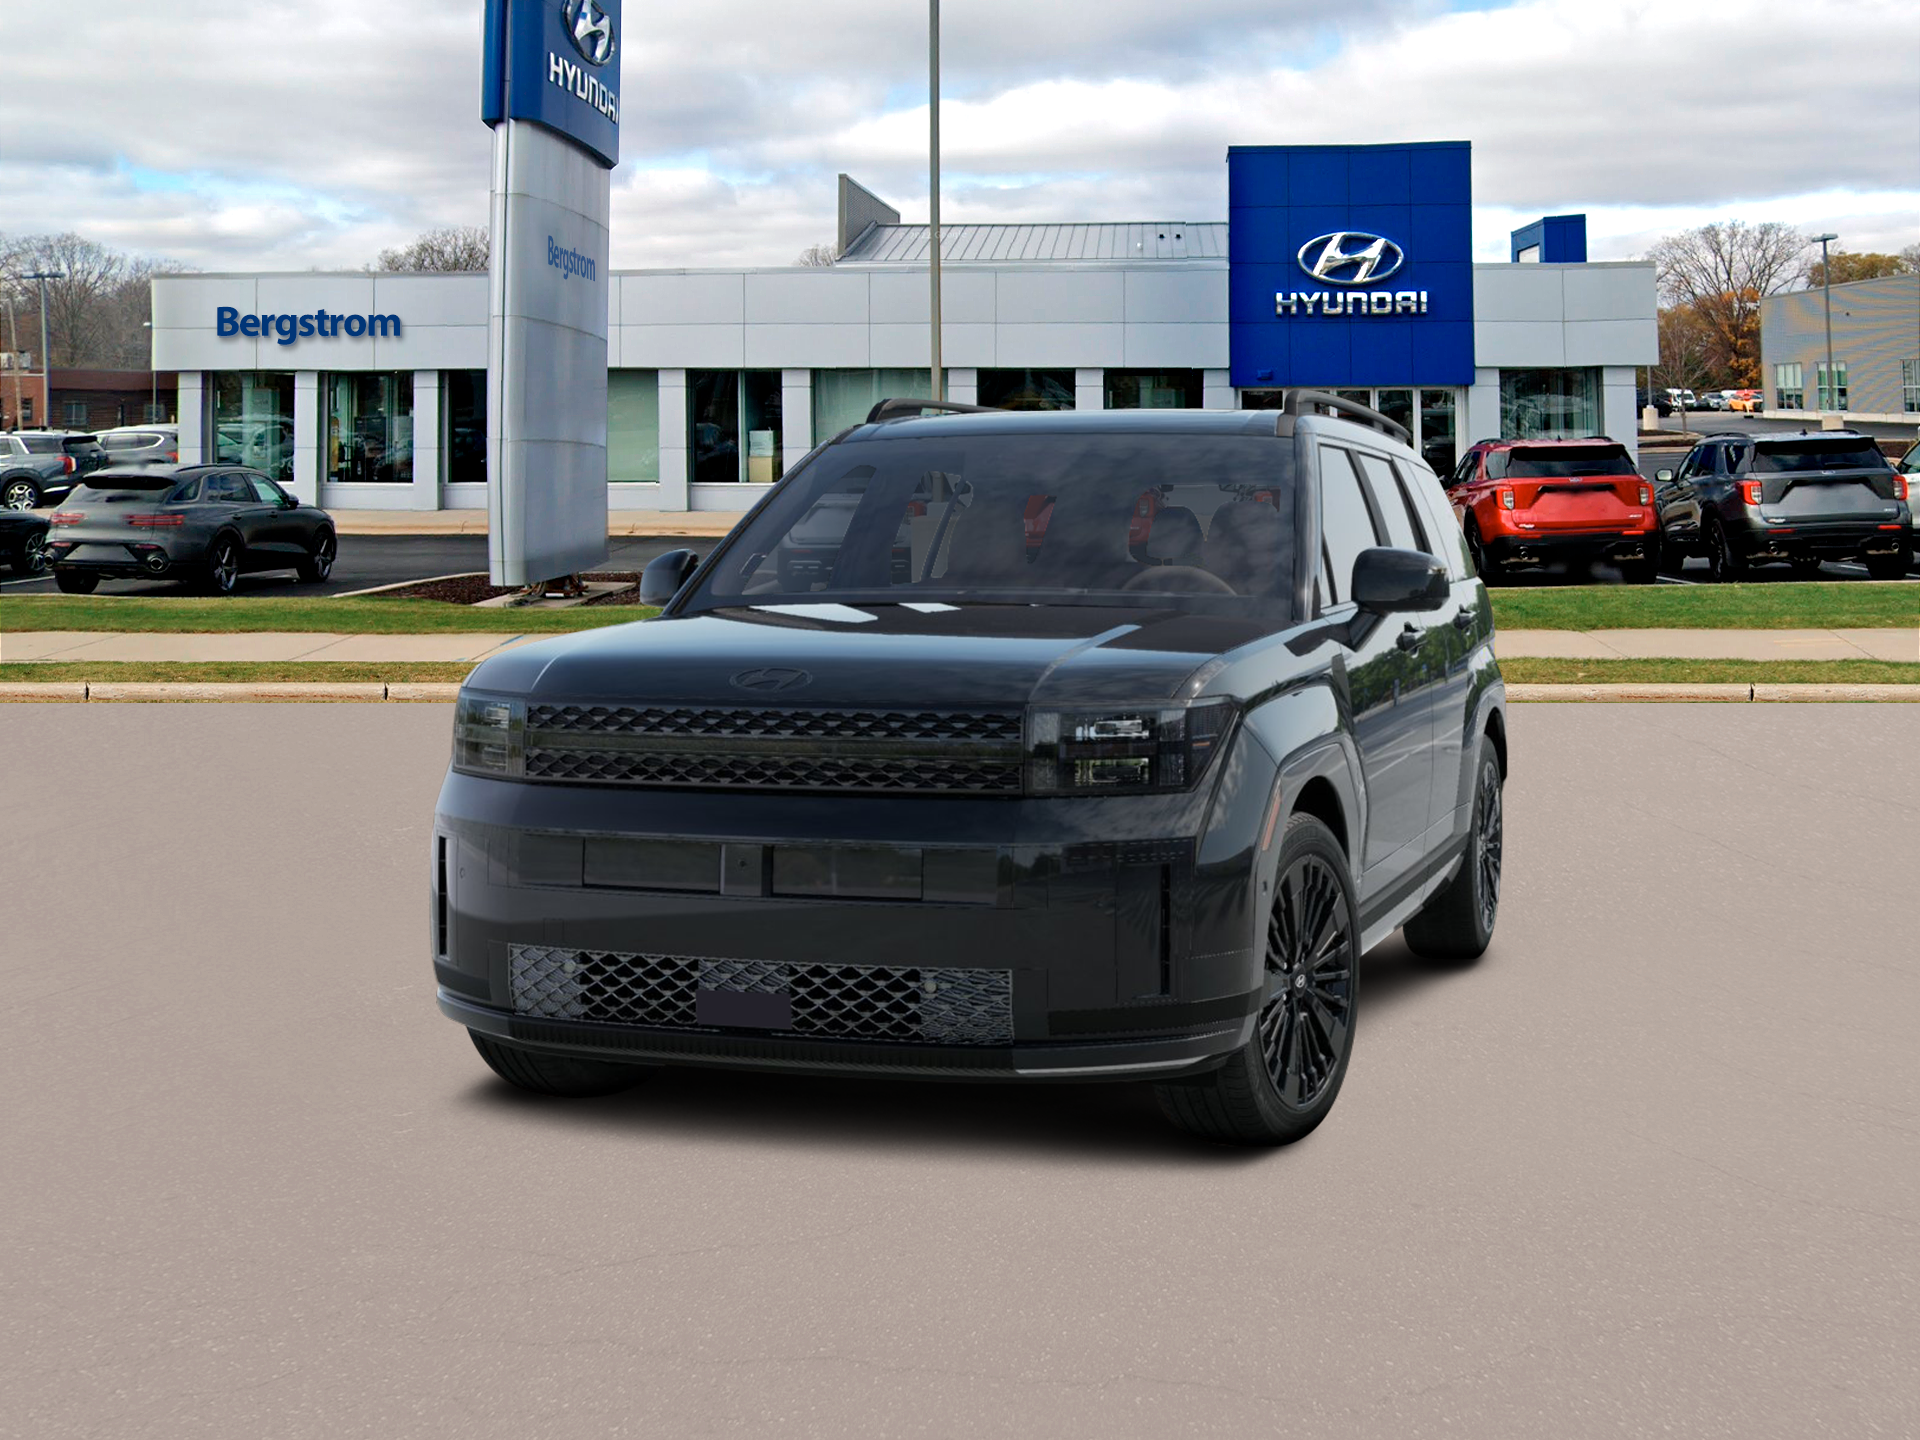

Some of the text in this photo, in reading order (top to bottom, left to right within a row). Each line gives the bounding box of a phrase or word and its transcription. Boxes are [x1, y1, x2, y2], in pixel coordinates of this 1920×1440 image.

[549, 52, 618, 124] HYUNDAI
[547, 235, 595, 281] Bergstrom
[1275, 291, 1428, 315] HYUNDAI
[217, 306, 401, 346] Bergstrom
